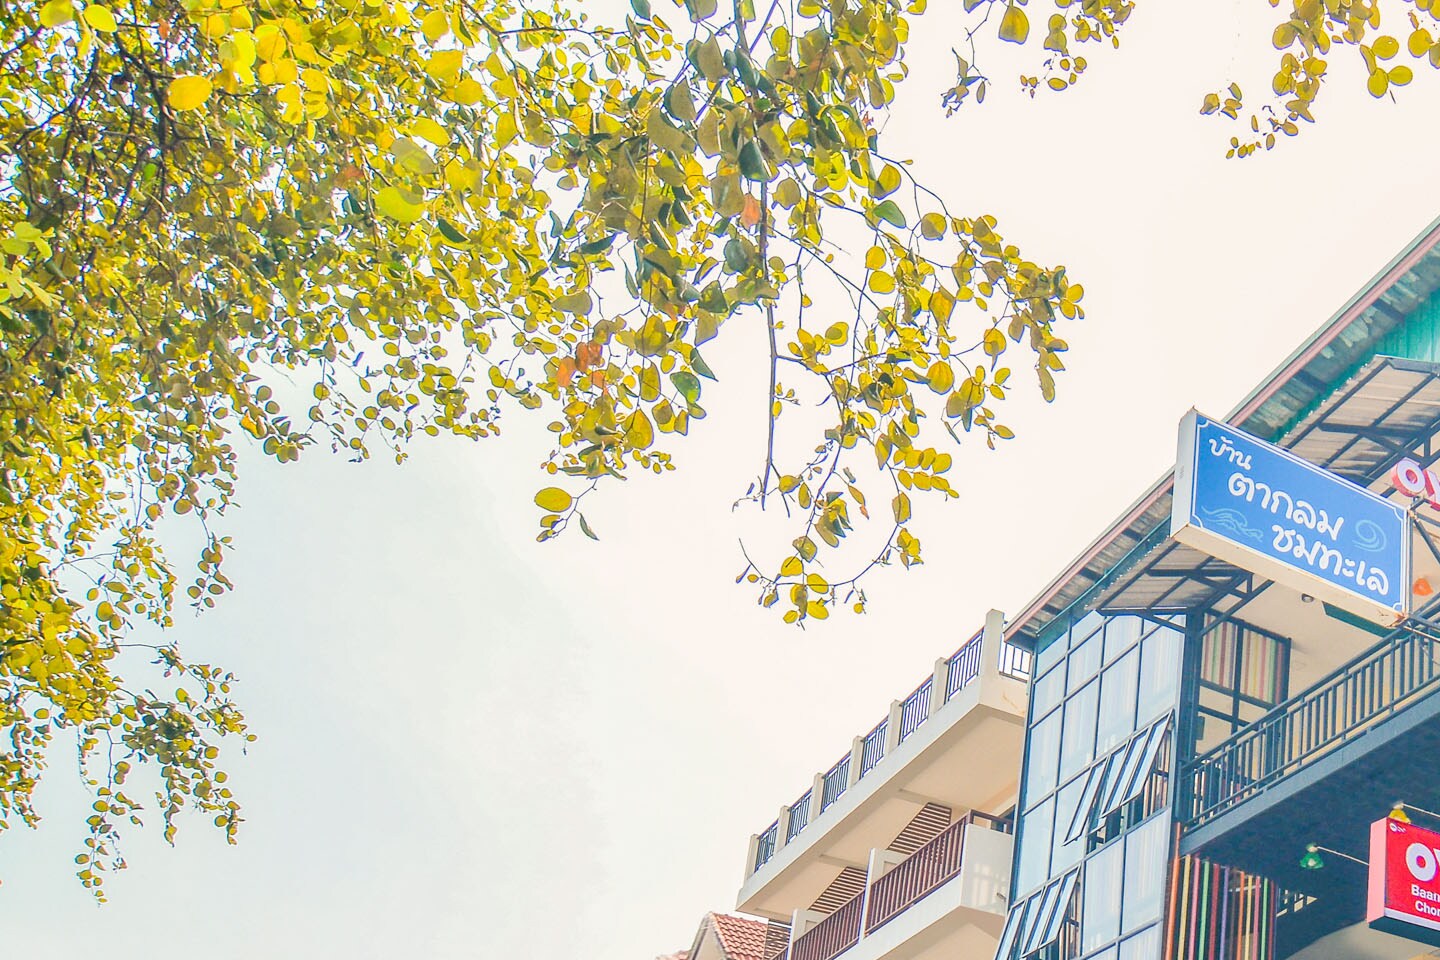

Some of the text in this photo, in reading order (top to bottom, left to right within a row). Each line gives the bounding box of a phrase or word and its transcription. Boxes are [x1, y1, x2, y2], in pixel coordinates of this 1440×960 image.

[1209, 436, 1252, 470] บ้าน
[1228, 472, 1345, 541] ตากลม
[1271, 523, 1390, 596] ชมทะเล
[1411, 883, 1440, 903] Baan
